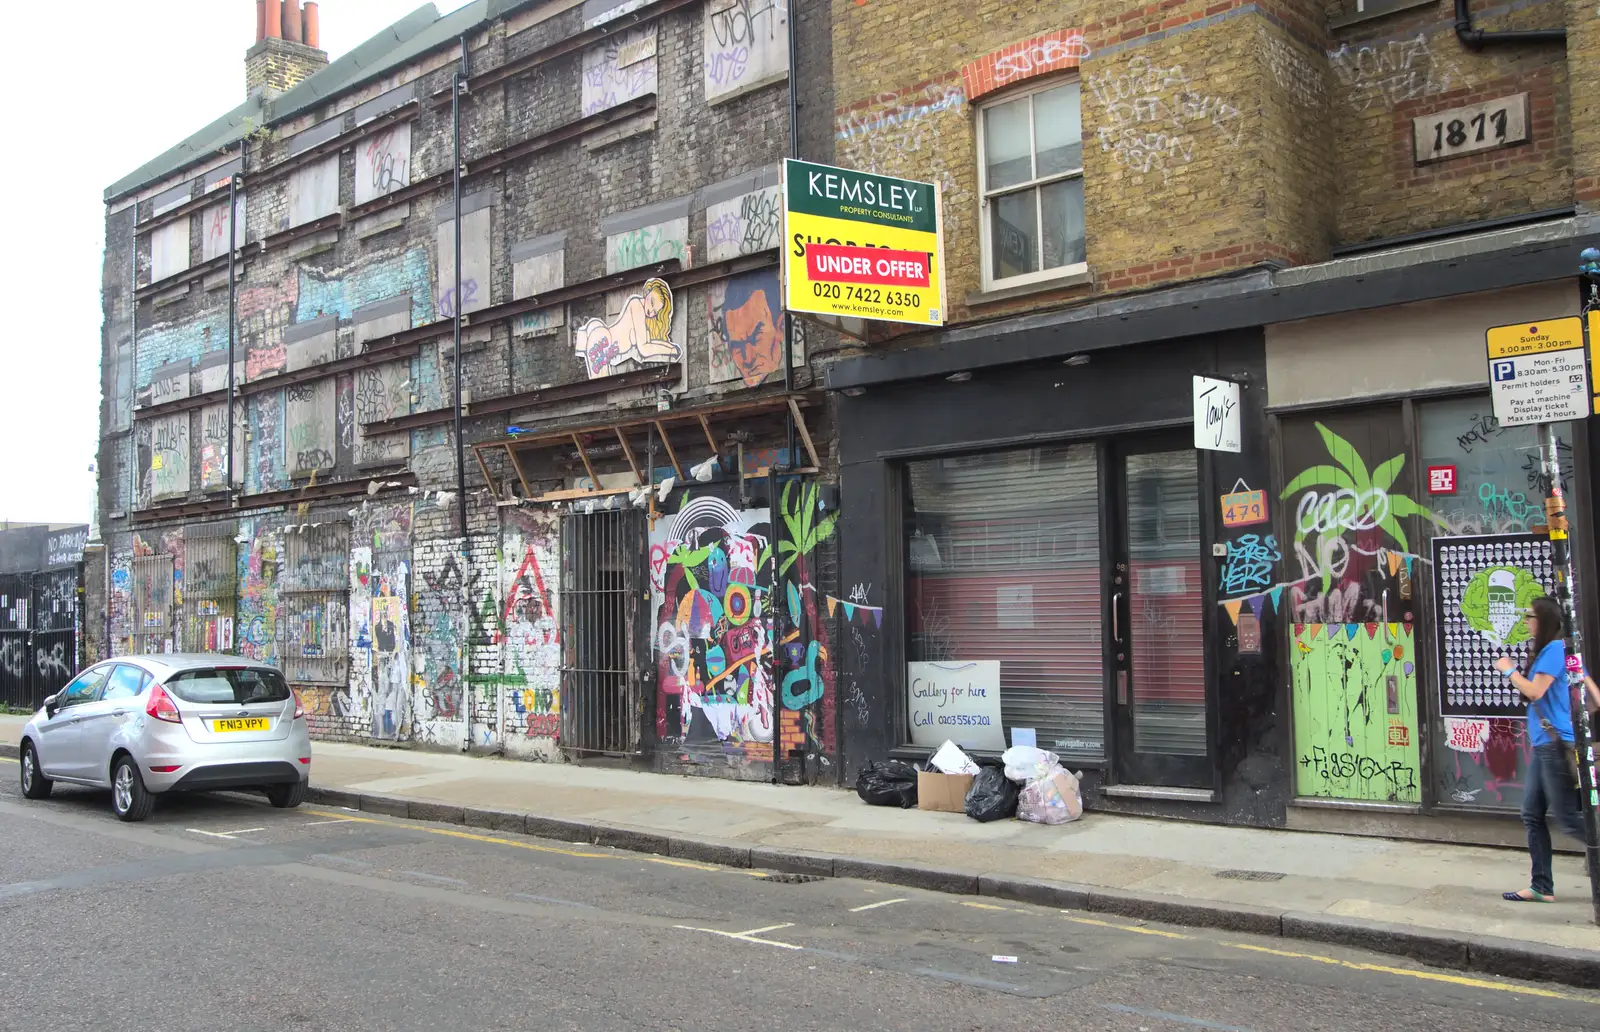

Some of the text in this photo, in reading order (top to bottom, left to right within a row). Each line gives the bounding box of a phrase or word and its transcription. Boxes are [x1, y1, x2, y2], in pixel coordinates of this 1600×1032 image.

[1433, 108, 1507, 151] 1877
[809, 171, 917, 211] KEMSLEY
[840, 205, 914, 223] PROPERTY CONSULTANTS
[816, 255, 924, 279] UNDER OFFER
[814, 283, 920, 308] 020 7422 6350
[832, 303, 904, 317] www.kemsley.com
[1520, 335, 1550, 343] Sunday
[1497, 363, 1512, 380] P
[1501, 382, 1528, 390] Permit
[1537, 394, 1571, 402] machine
[1199, 386, 1236, 447] Tony's
[1514, 402, 1569, 414] Display ticket
[1225, 491, 1261, 505] ROOM
[1225, 504, 1260, 521] 479
[48, 531, 87, 552] NO PARKING
[912, 678, 986, 708] Gallery for hire
[220, 719, 263, 730] FN13 VPY
[913, 710, 990, 727] Call 02035565201
